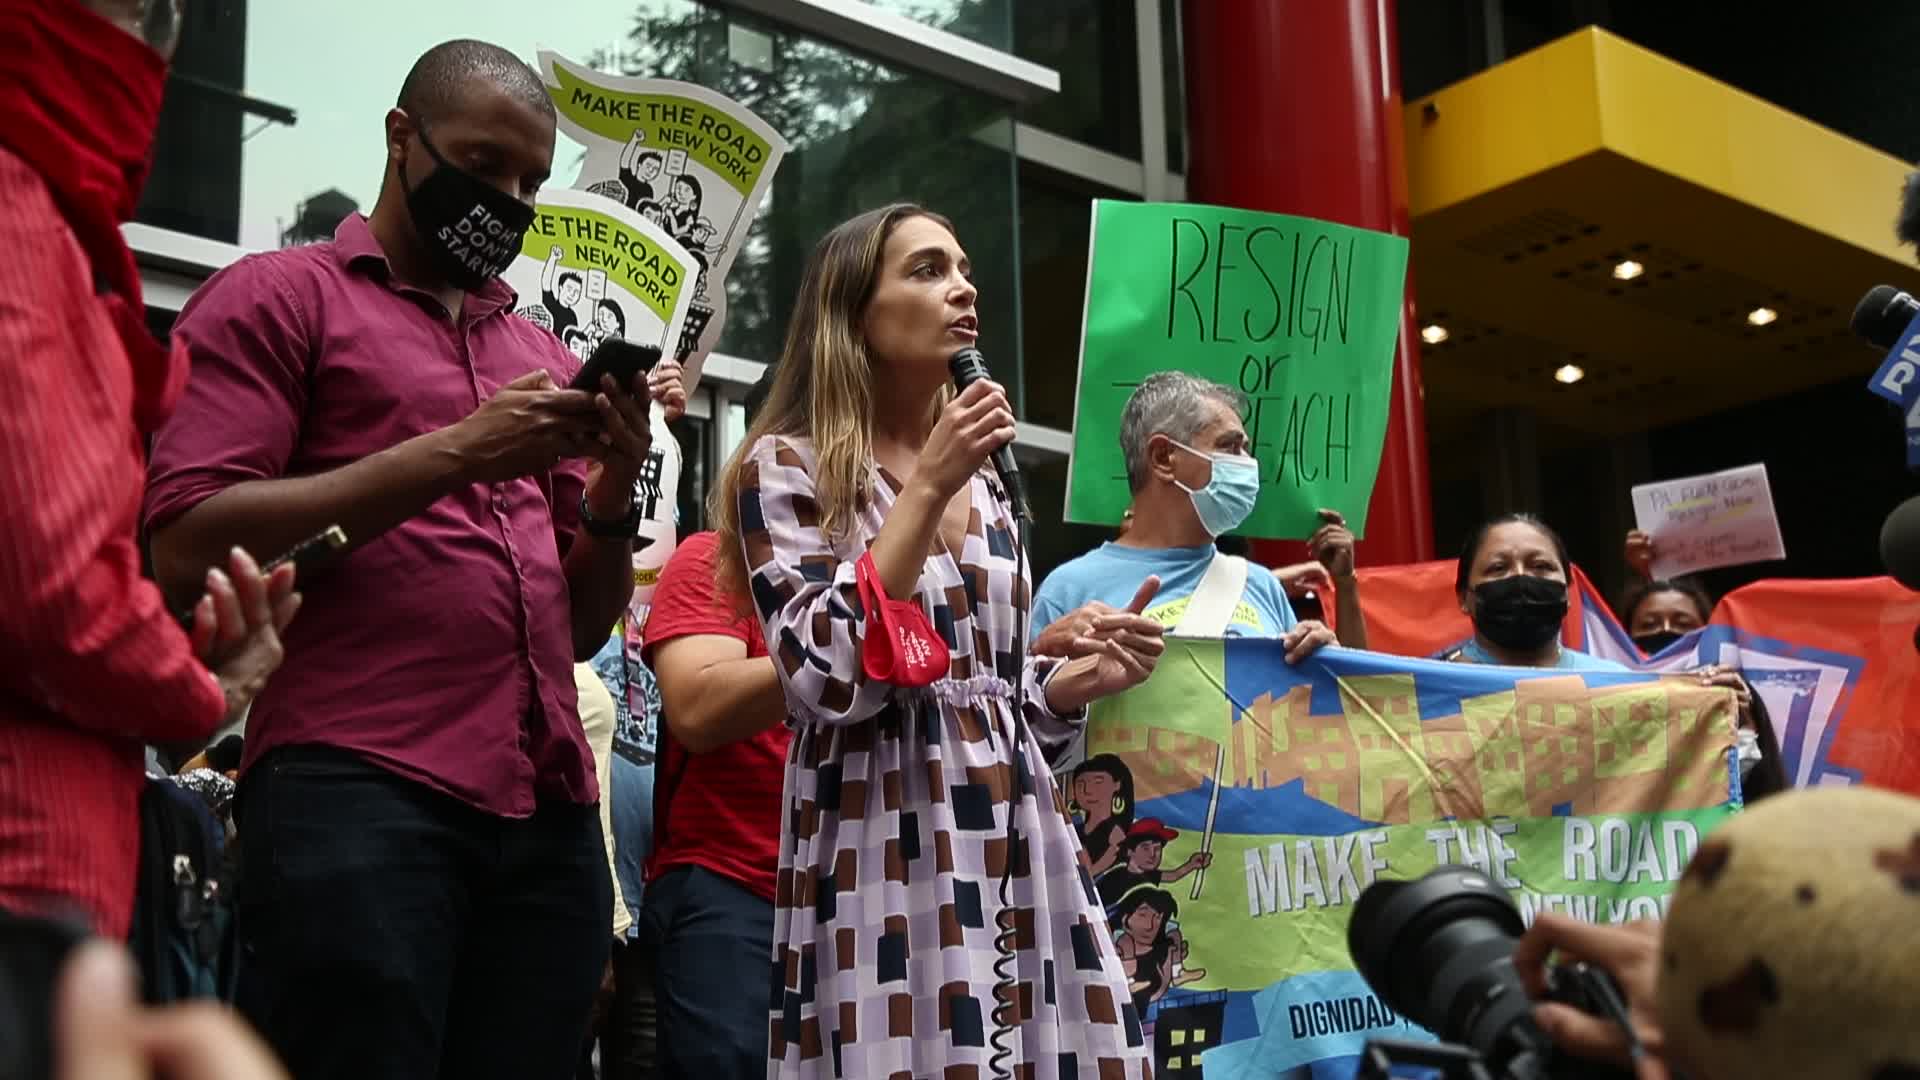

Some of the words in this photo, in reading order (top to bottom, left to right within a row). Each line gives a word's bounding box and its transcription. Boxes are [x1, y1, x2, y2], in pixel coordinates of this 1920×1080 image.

[571, 88, 641, 121] MAKE
[646, 102, 695, 127] THE
[699, 113, 762, 164] ROAD
[658, 127, 704, 150] NEW
[708, 143, 752, 184] YORK
[469, 203, 518, 244] FIGH
[560, 217, 609, 244] THE
[613, 229, 678, 287] ROAD
[575, 243, 620, 271] NEW
[625, 263, 671, 310] YORK
[1167, 217, 1354, 355] RESIGN
[1239, 354, 1291, 394] or
[1563, 816, 1700, 885] ROAD
